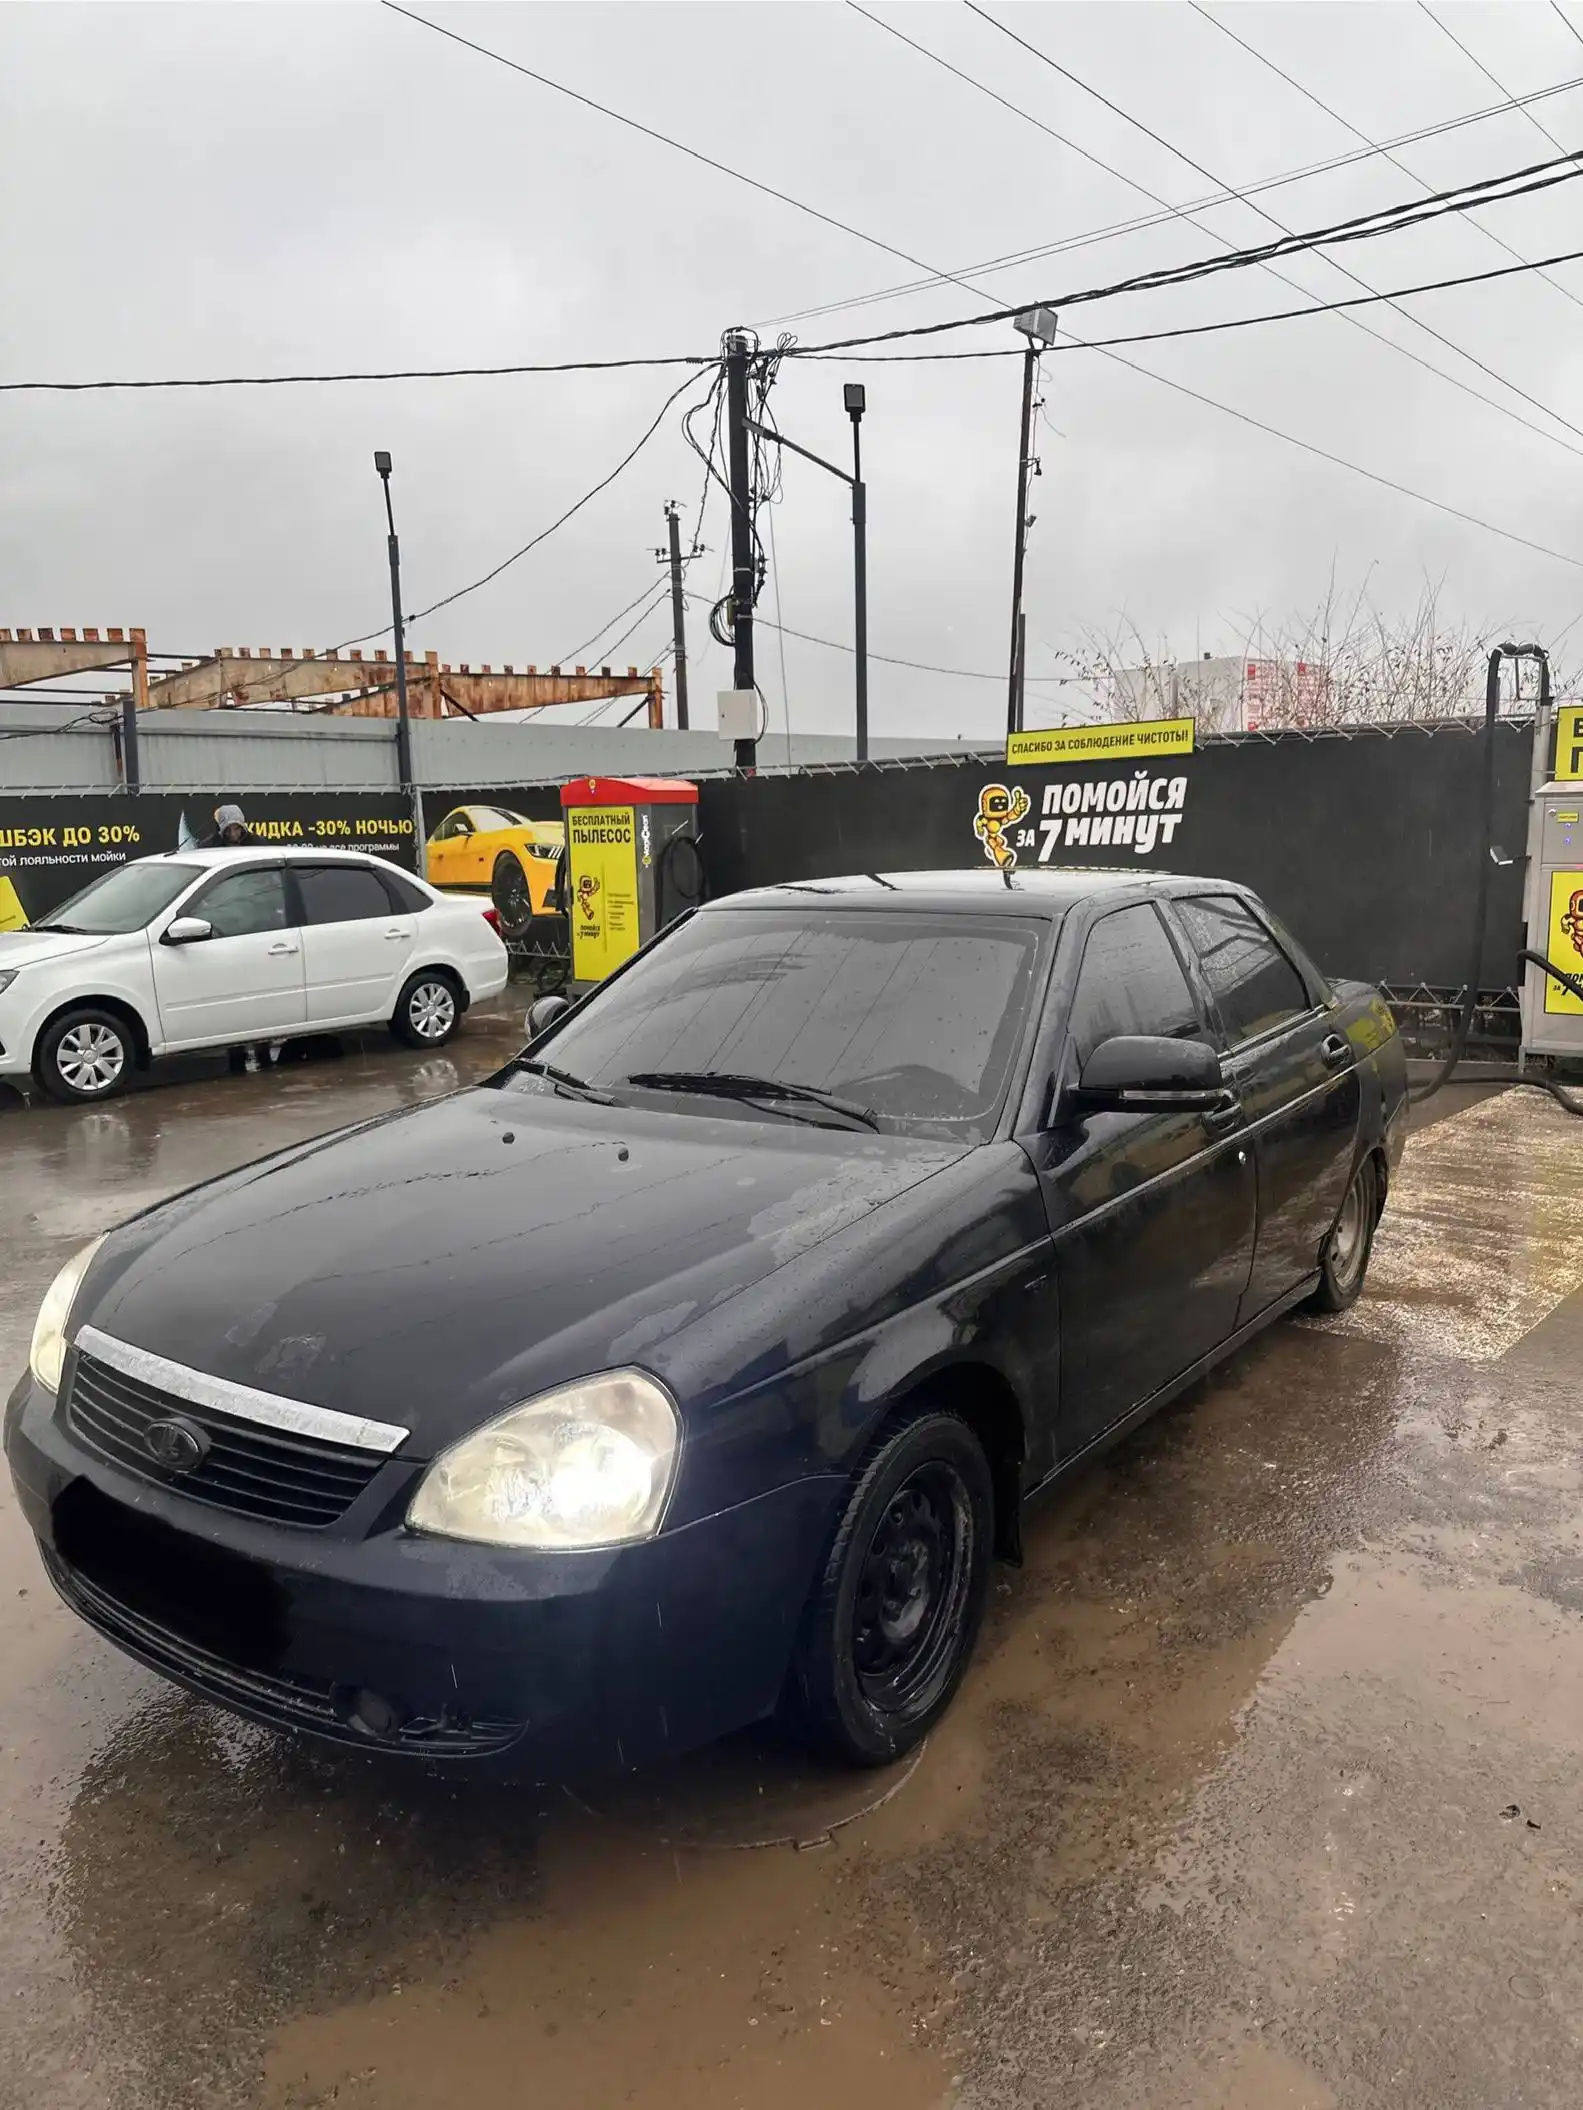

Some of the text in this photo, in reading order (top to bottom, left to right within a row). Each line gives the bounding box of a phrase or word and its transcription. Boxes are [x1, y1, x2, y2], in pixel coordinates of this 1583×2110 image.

[1011, 729, 1189, 754] СПАСИБО ЗА СОБЛЮДЕНИЕ ЧИСТОТЫ!
[1041, 770, 1188, 815] ПОМОЙСЯ
[244, 819, 414, 839] КИДКА -30% НОЧЬЮ
[572, 812, 631, 826] БЕСПЛАТНЫЙ
[62, 826, 92, 847] ДО
[98, 824, 141, 844] 30%
[573, 828, 632, 844] ПЫЛЕСОС
[1015, 813, 1183, 863] ЗА 7 МИНУТ
[20, 853, 89, 867] лояльности
[91, 850, 127, 863] мойки
